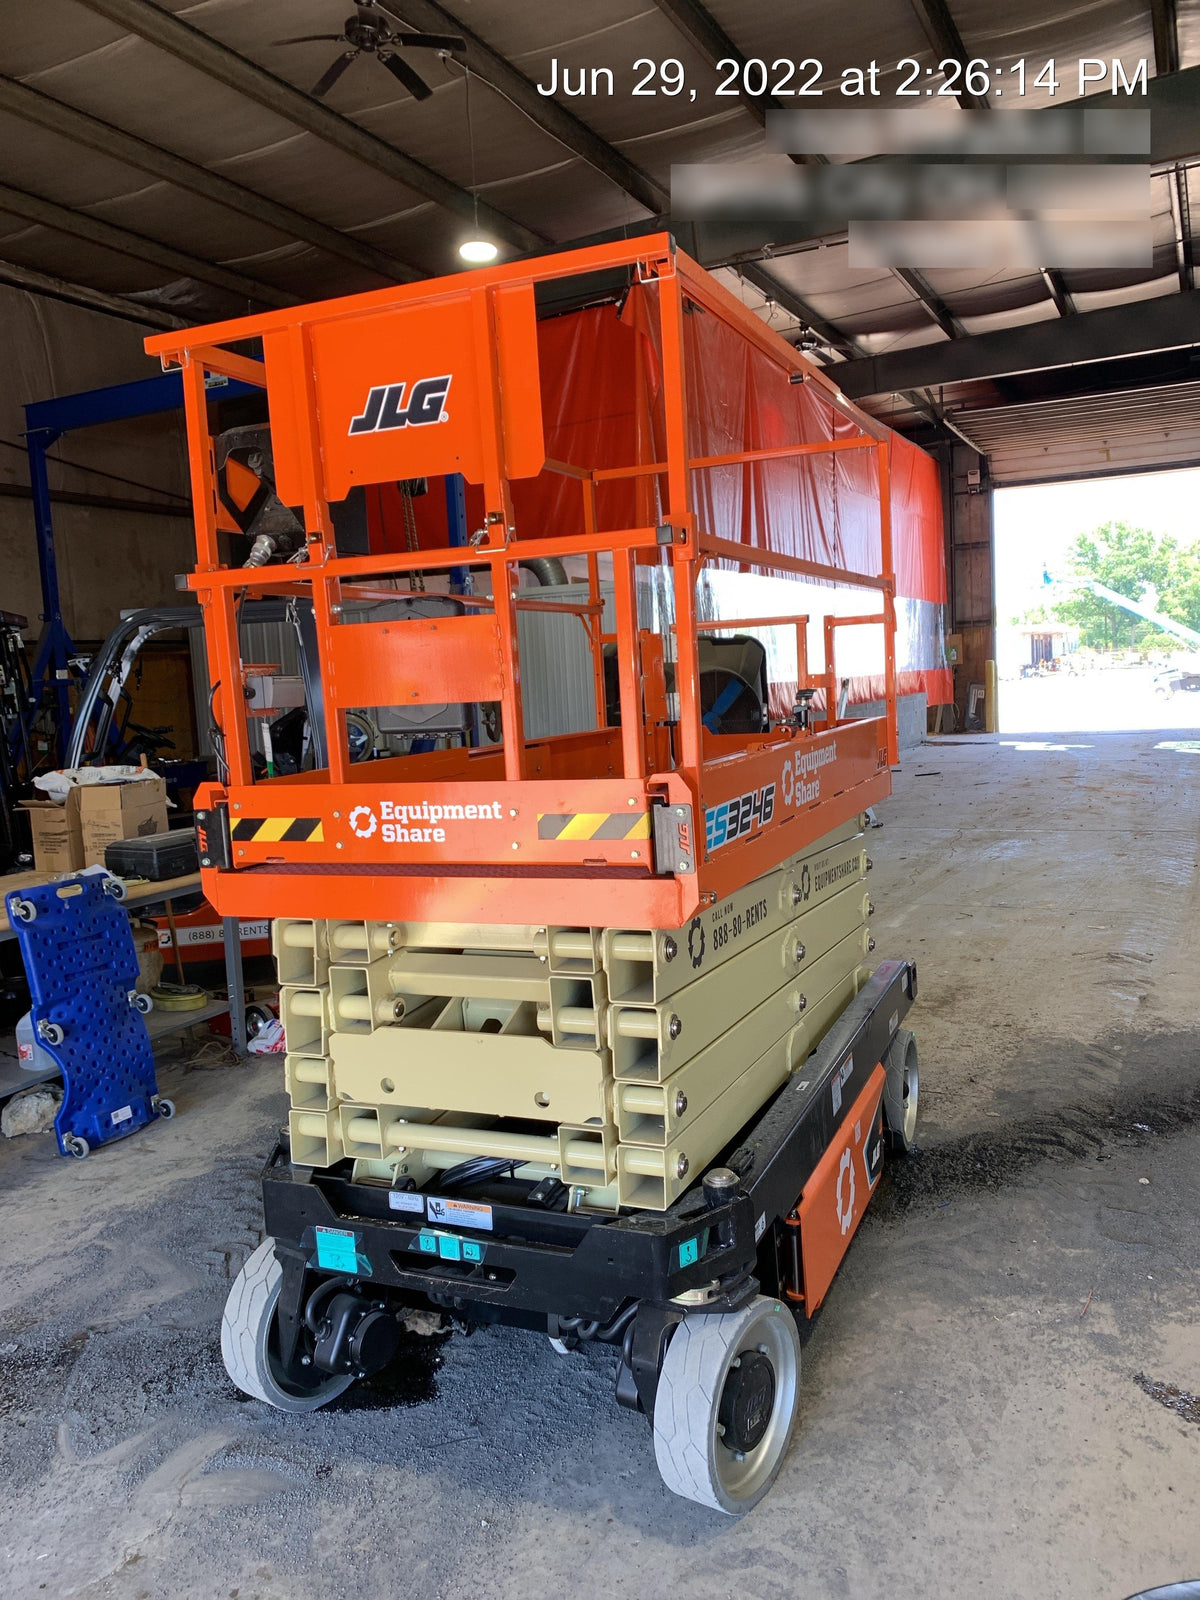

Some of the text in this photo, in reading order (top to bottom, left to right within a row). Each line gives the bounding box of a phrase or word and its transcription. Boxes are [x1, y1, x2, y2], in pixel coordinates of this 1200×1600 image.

[348, 374, 452, 436] JLG
[795, 739, 837, 779] Equipment
[795, 779, 820, 807] Share
[379, 800, 503, 824] Equipment
[705, 782, 776, 854] ES3246
[381, 823, 446, 843] Share
[677, 822, 691, 856] JLG
[188, 930, 215, 942] (888)
[713, 898, 768, 951] 888-80-RENTS
